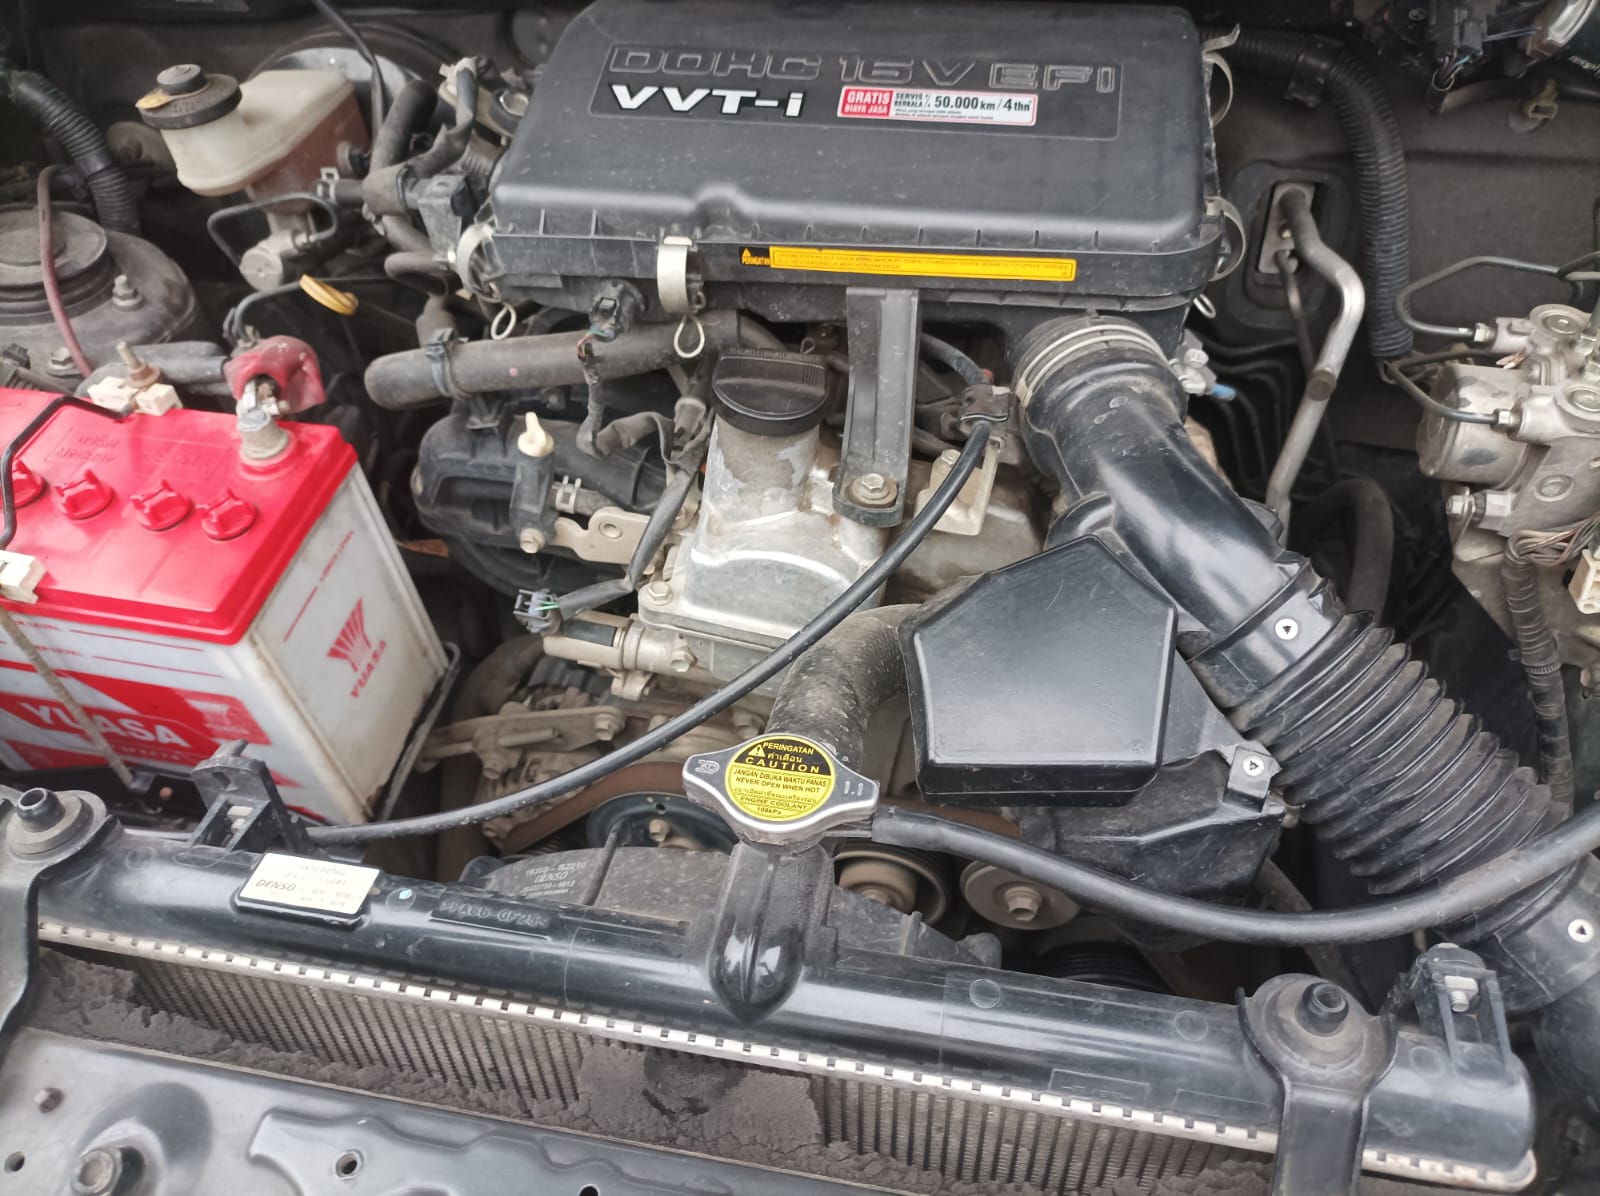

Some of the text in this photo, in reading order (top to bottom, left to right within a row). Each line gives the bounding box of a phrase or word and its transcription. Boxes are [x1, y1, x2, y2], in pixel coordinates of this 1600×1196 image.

[608, 48, 822, 80] DOHC
[988, 62, 1116, 93] EFI
[611, 84, 804, 117] VVT-i
[847, 90, 891, 105] GRATIS
[894, 100, 924, 108] BERKALA
[895, 93, 923, 101] SERVIS
[934, 95, 979, 110] 50.000
[844, 104, 867, 113] BIAYA
[867, 104, 888, 114] JASA
[350, 639, 387, 699] YUASA
[762, 741, 814, 755] PERINGATAN
[745, 756, 820, 773] CAUTION
[733, 769, 827, 787] JANGAN DIBUKA WAKTU PANAS
[735, 776, 759, 785] NEVER
[760, 780, 780, 788] OPEN
[782, 783, 803, 792] WHEN
[843, 780, 864, 797] 1.1
[740, 795, 808, 810] ENGINE COOLANT
[533, 870, 569, 883] DENSO
[255, 879, 297, 892] DENSO
